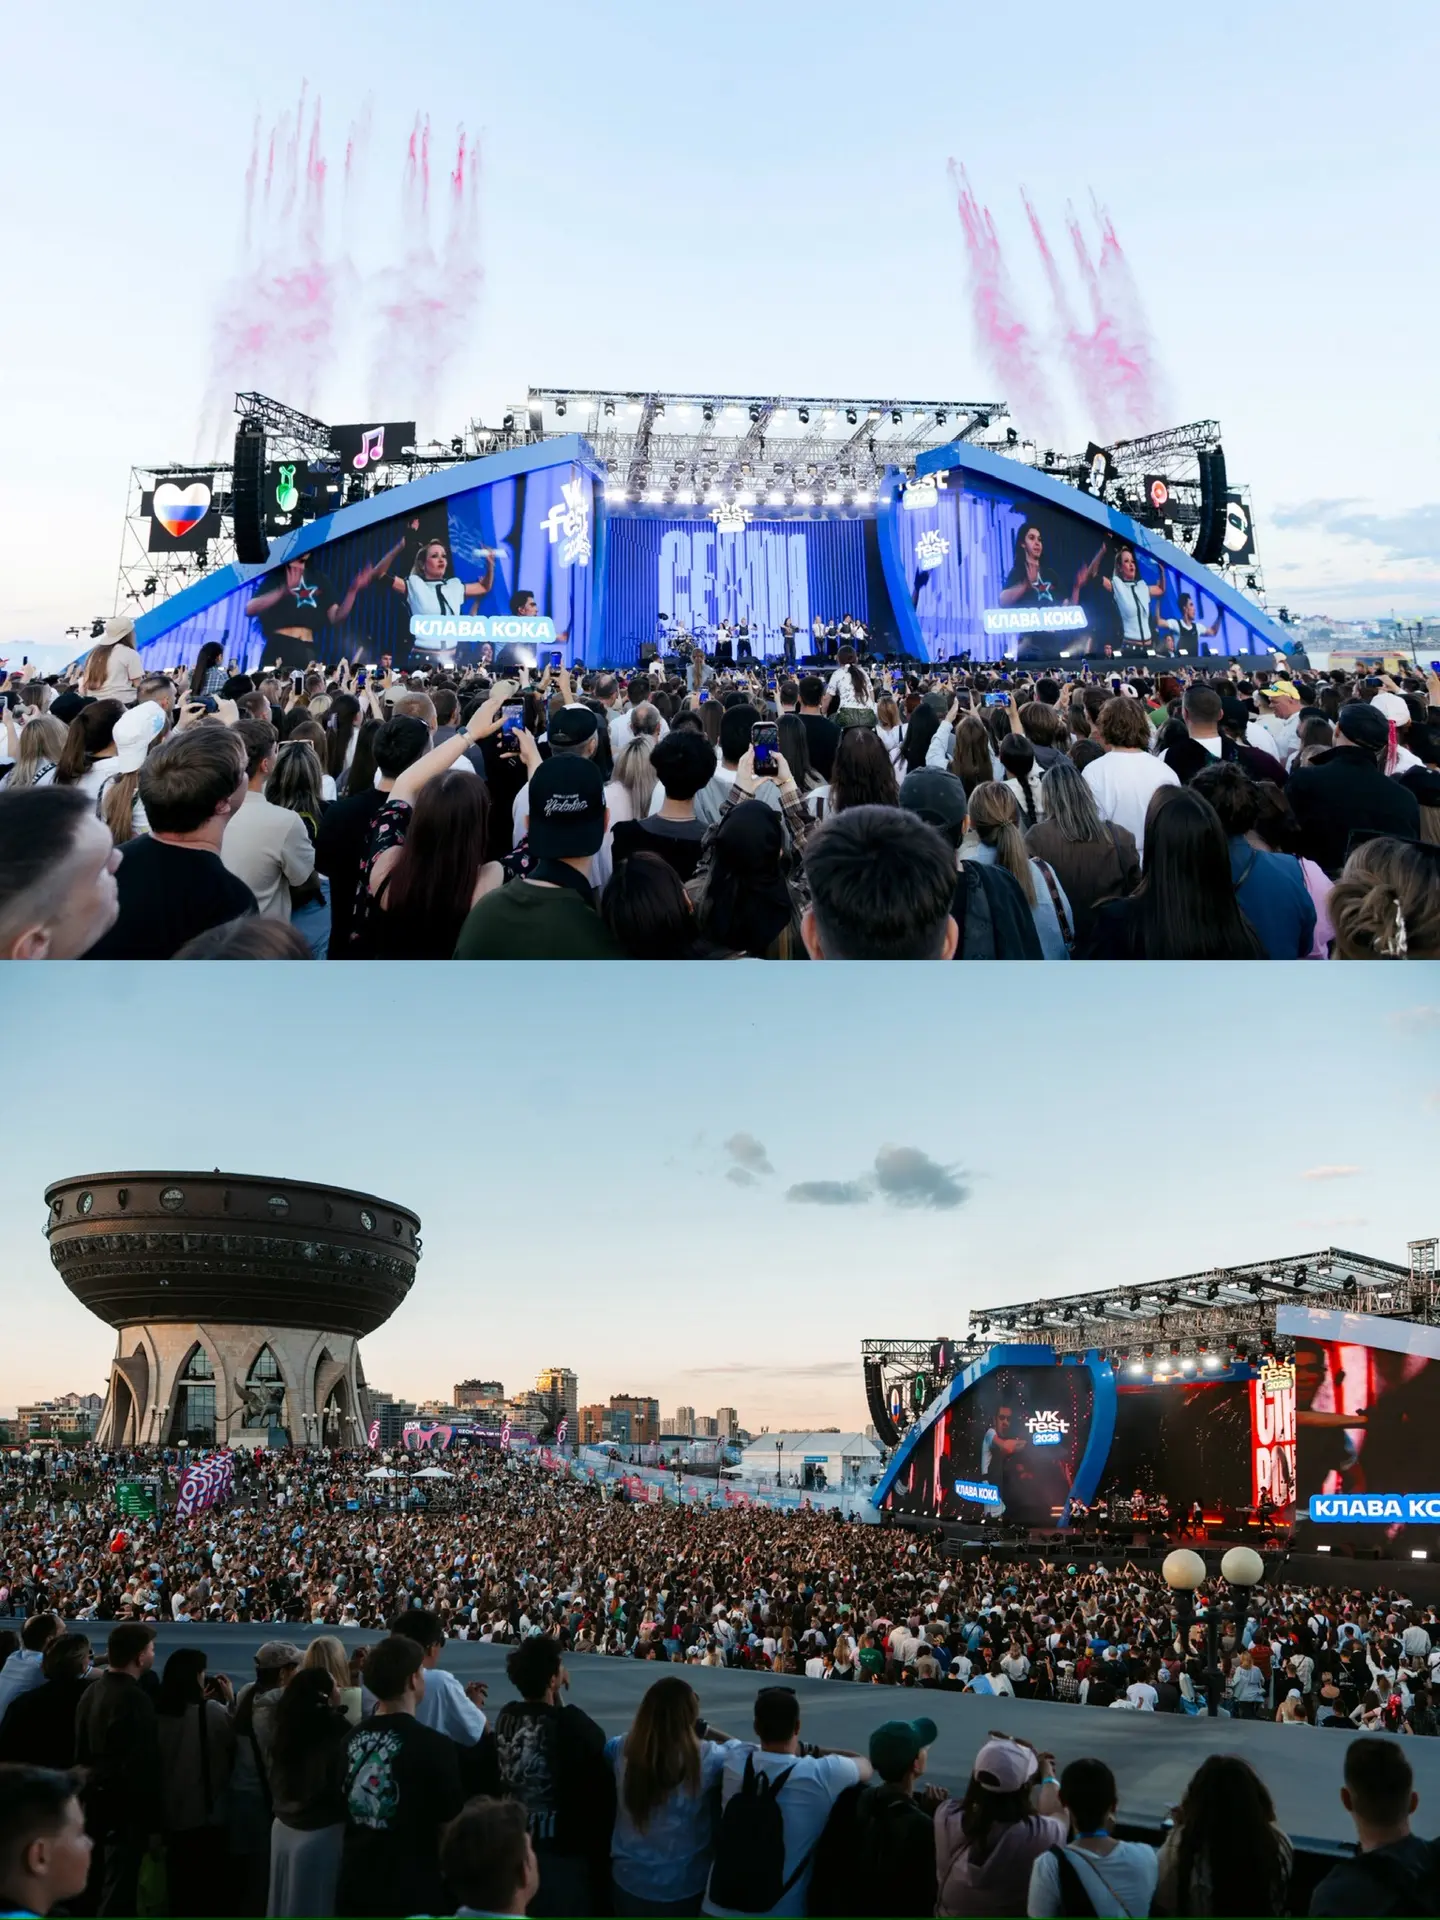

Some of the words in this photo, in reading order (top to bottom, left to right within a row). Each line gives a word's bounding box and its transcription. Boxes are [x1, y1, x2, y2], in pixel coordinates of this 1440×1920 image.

[899, 470, 950, 491] est
[708, 509, 754, 523] fest
[921, 529, 940, 545] VK
[914, 537, 950, 559] fest
[987, 613, 1040, 629] КЛАВА
[1043, 610, 1085, 626] КОКА
[414, 619, 486, 637] КЛАВА
[492, 622, 551, 638] КОКА
[1257, 1365, 1296, 1382] fest
[1267, 1380, 1291, 1390] 2026
[1034, 1410, 1060, 1422] VK
[1024, 1418, 1070, 1434] fest
[1035, 1433, 1060, 1443] 2026
[955, 1484, 978, 1499] КЛАВА
[978, 1487, 998, 1501] КОКА
[1315, 1500, 1403, 1517] КЛАВА
